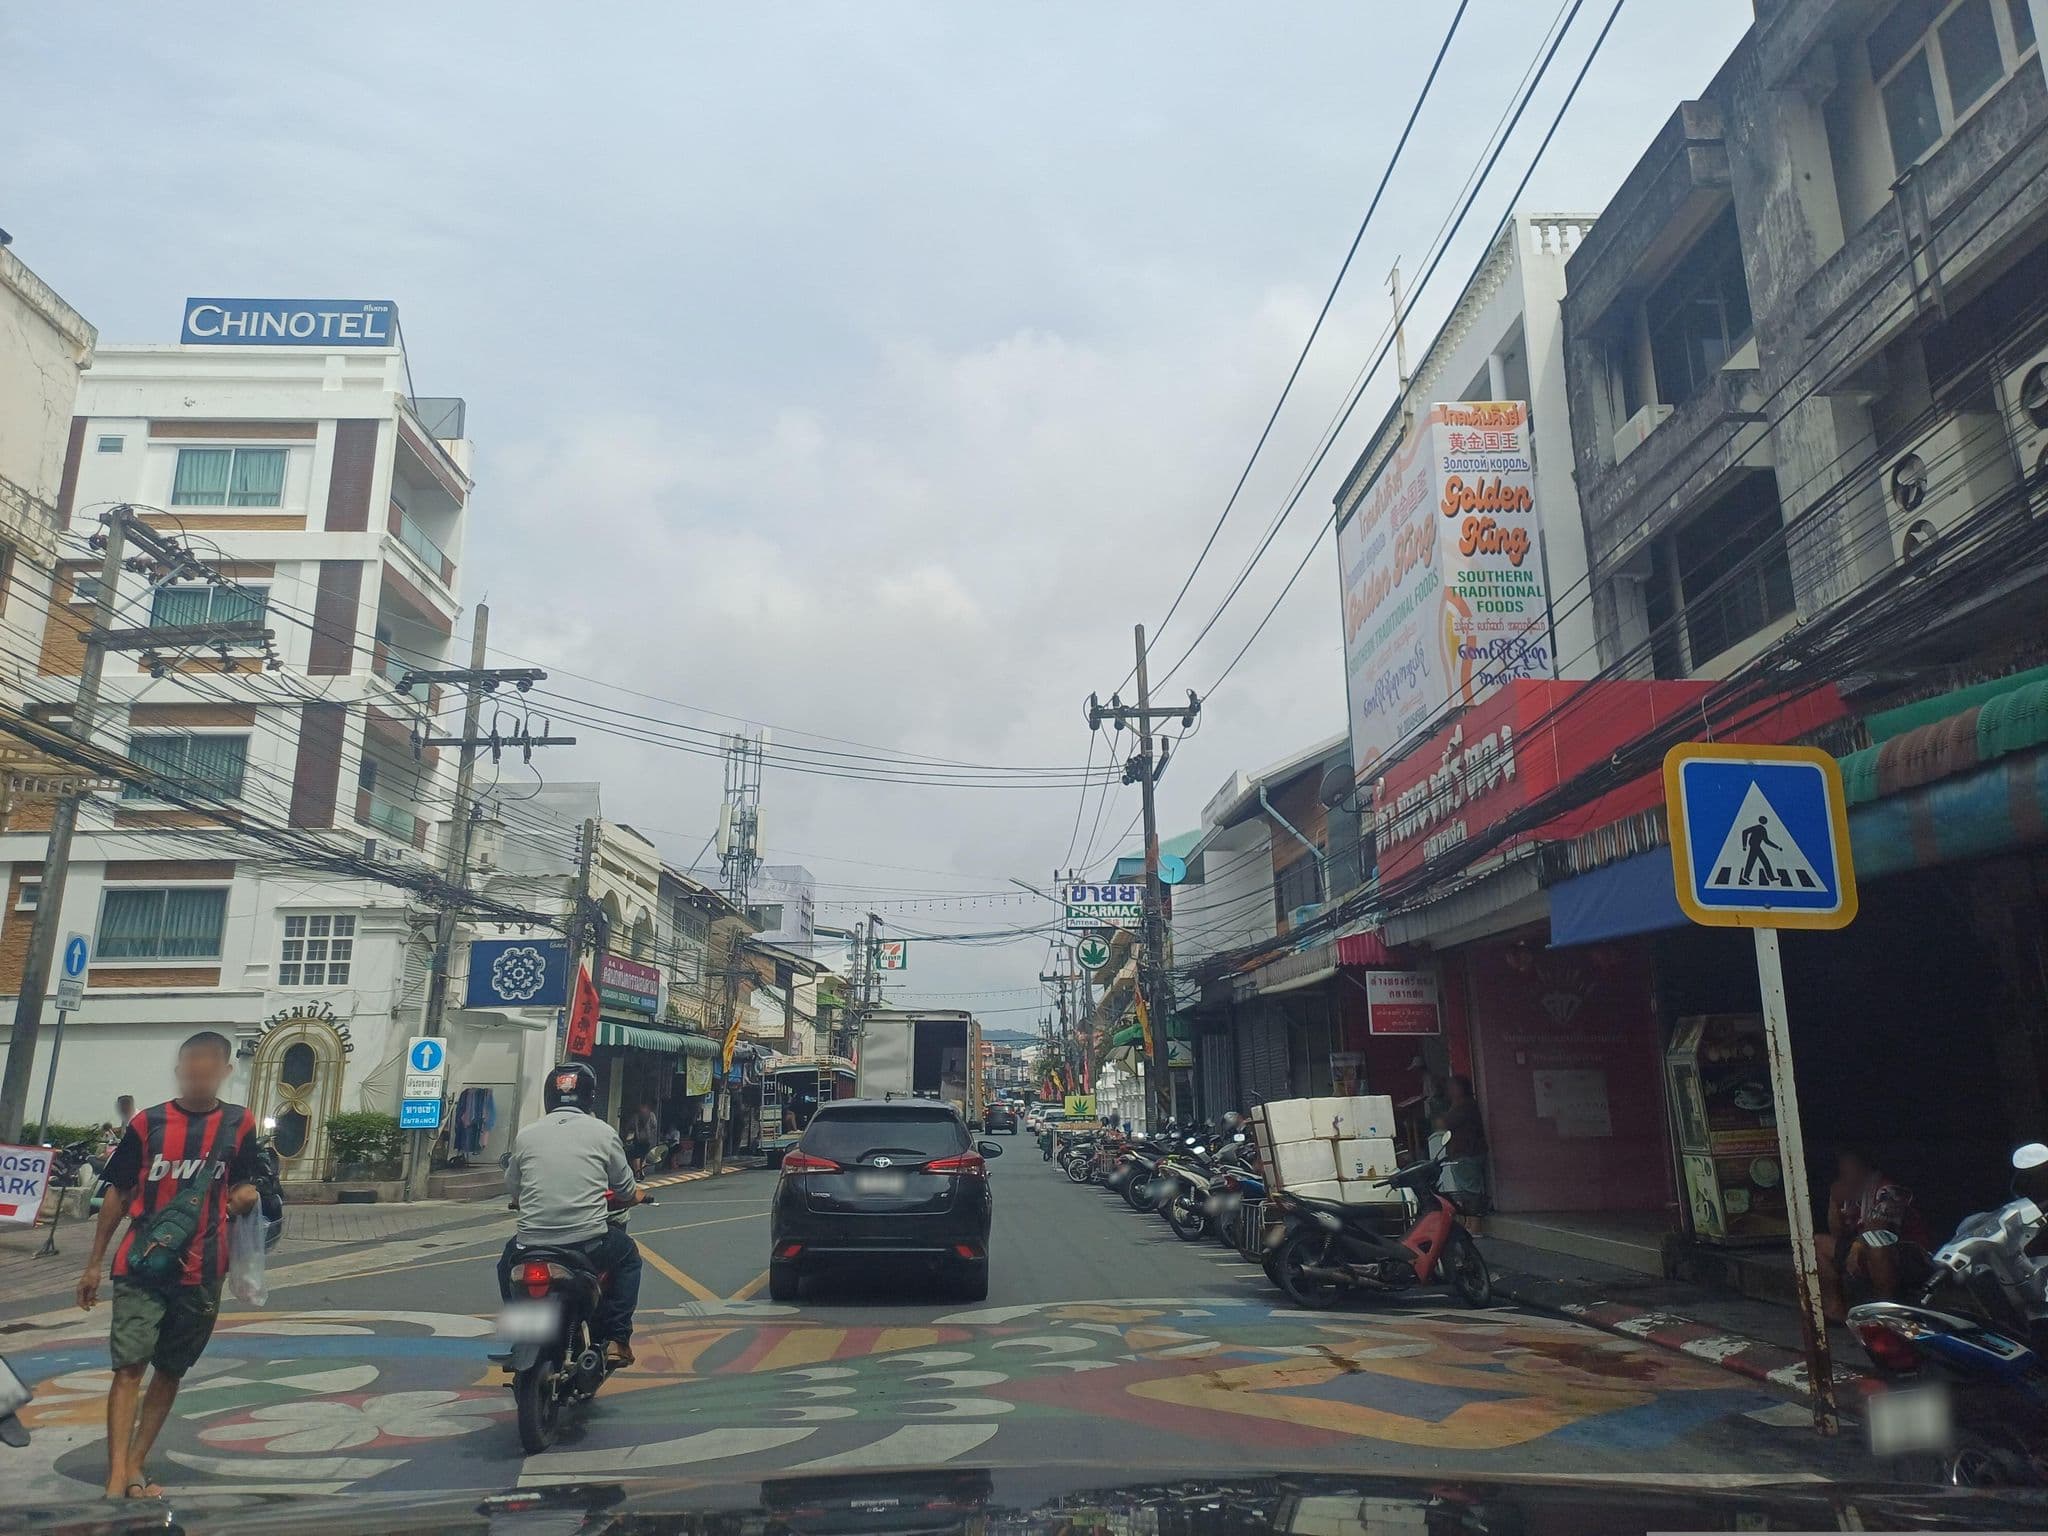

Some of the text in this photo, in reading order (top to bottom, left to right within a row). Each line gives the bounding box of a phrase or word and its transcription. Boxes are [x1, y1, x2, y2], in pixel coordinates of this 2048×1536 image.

[187, 304, 387, 339] CHINOTEL
[1443, 455, 1529, 475] Золотой король
[1441, 475, 1534, 518] Golden
[1459, 516, 1531, 567] King
[1457, 570, 1533, 583] SOUTHERN
[1450, 585, 1544, 598] TRADITIONAL
[1375, 594, 1415, 645] TRADITIONAL
[1414, 567, 1439, 606] FOODS
[1476, 600, 1524, 613] FOODS
[0, 1156, 46, 1174] ดรถ
